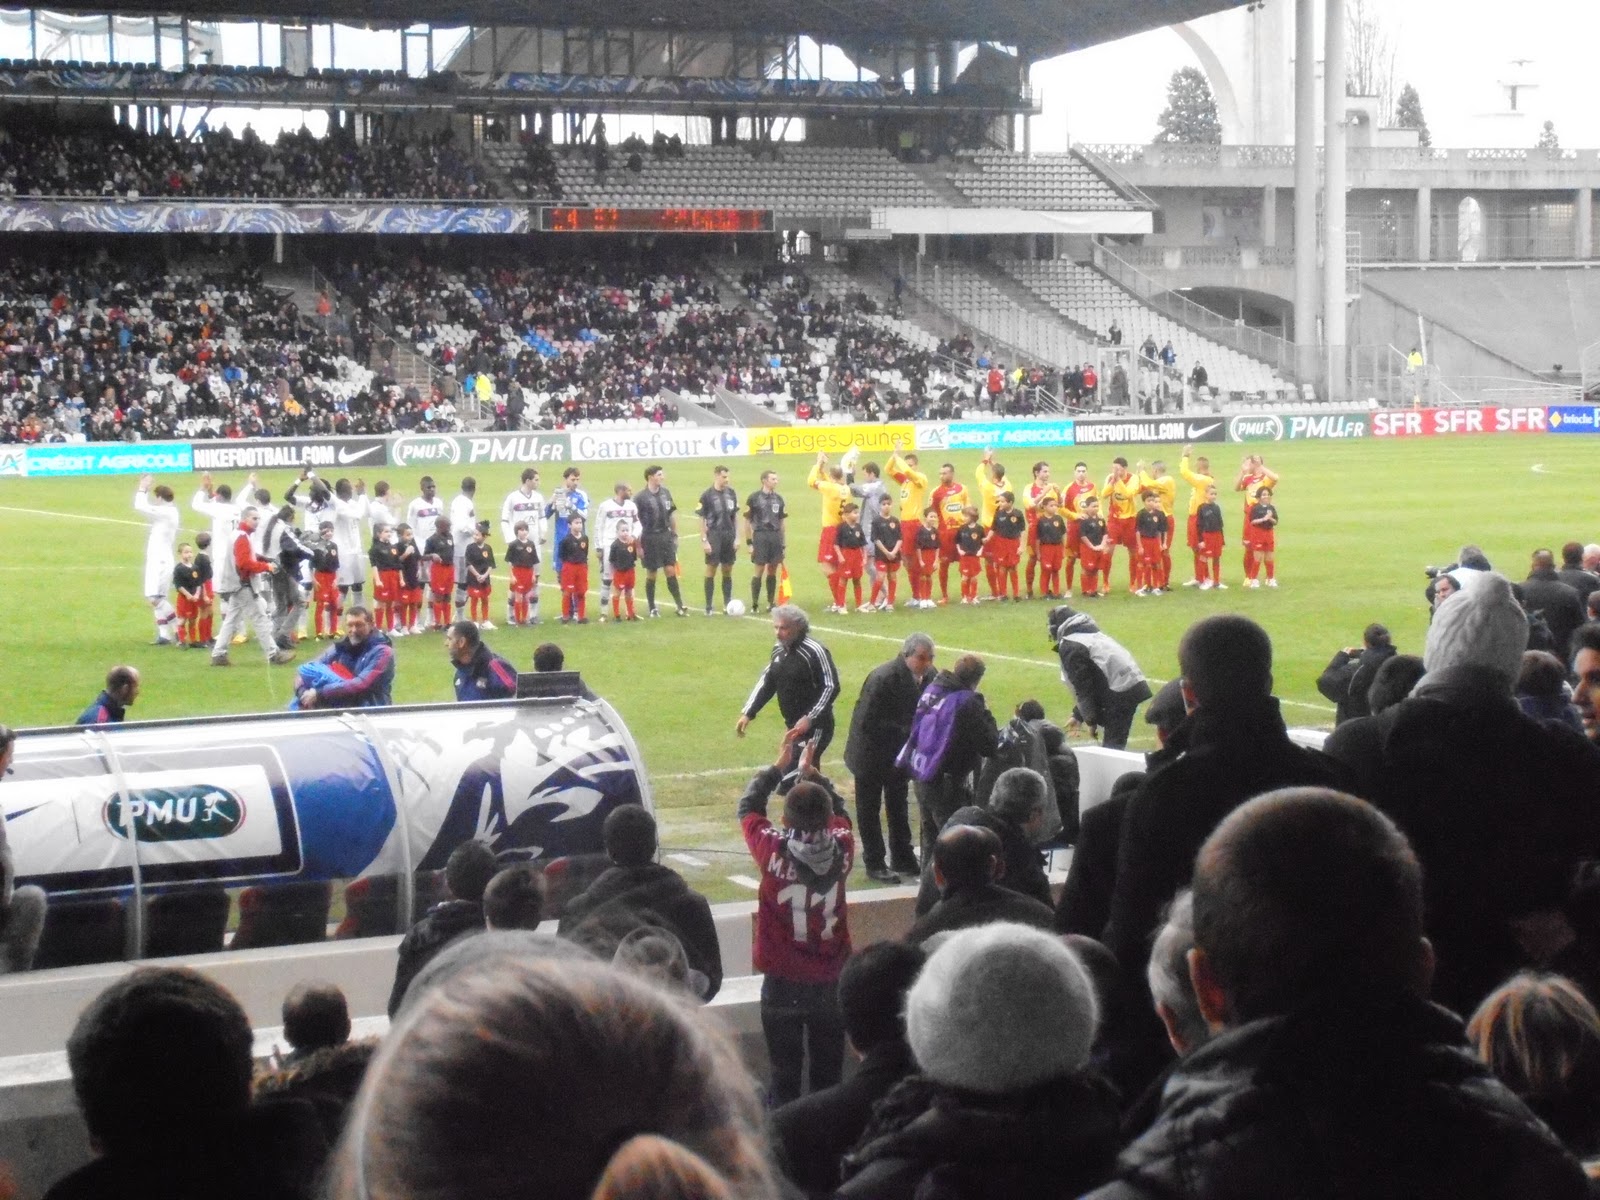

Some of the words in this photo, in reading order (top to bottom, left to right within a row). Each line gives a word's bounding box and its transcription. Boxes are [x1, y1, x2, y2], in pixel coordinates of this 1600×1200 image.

[1238, 422, 1264, 435] PMU
[1290, 415, 1364, 438] PMU.FR
[1374, 412, 1422, 435] SFR
[1434, 409, 1482, 432] SFR
[1496, 407, 1545, 430] SFR
[1563, 413, 1593, 424] brioche
[777, 433, 838, 452] Pages
[839, 431, 912, 448] Jaunes
[1003, 428, 1073, 442] AGRICOLE
[1075, 423, 1185, 443] NIKEFOOTBALL.COM
[402, 444, 436, 458] PMU
[468, 438, 563, 463] PMU.FR
[579, 434, 702, 458] Carrefour
[98, 453, 191, 468] AGRICOLE
[194, 446, 334, 468] NIKEFOOTBALL.COM
[116, 797, 197, 826] PMU
[777, 881, 839, 941] 11
